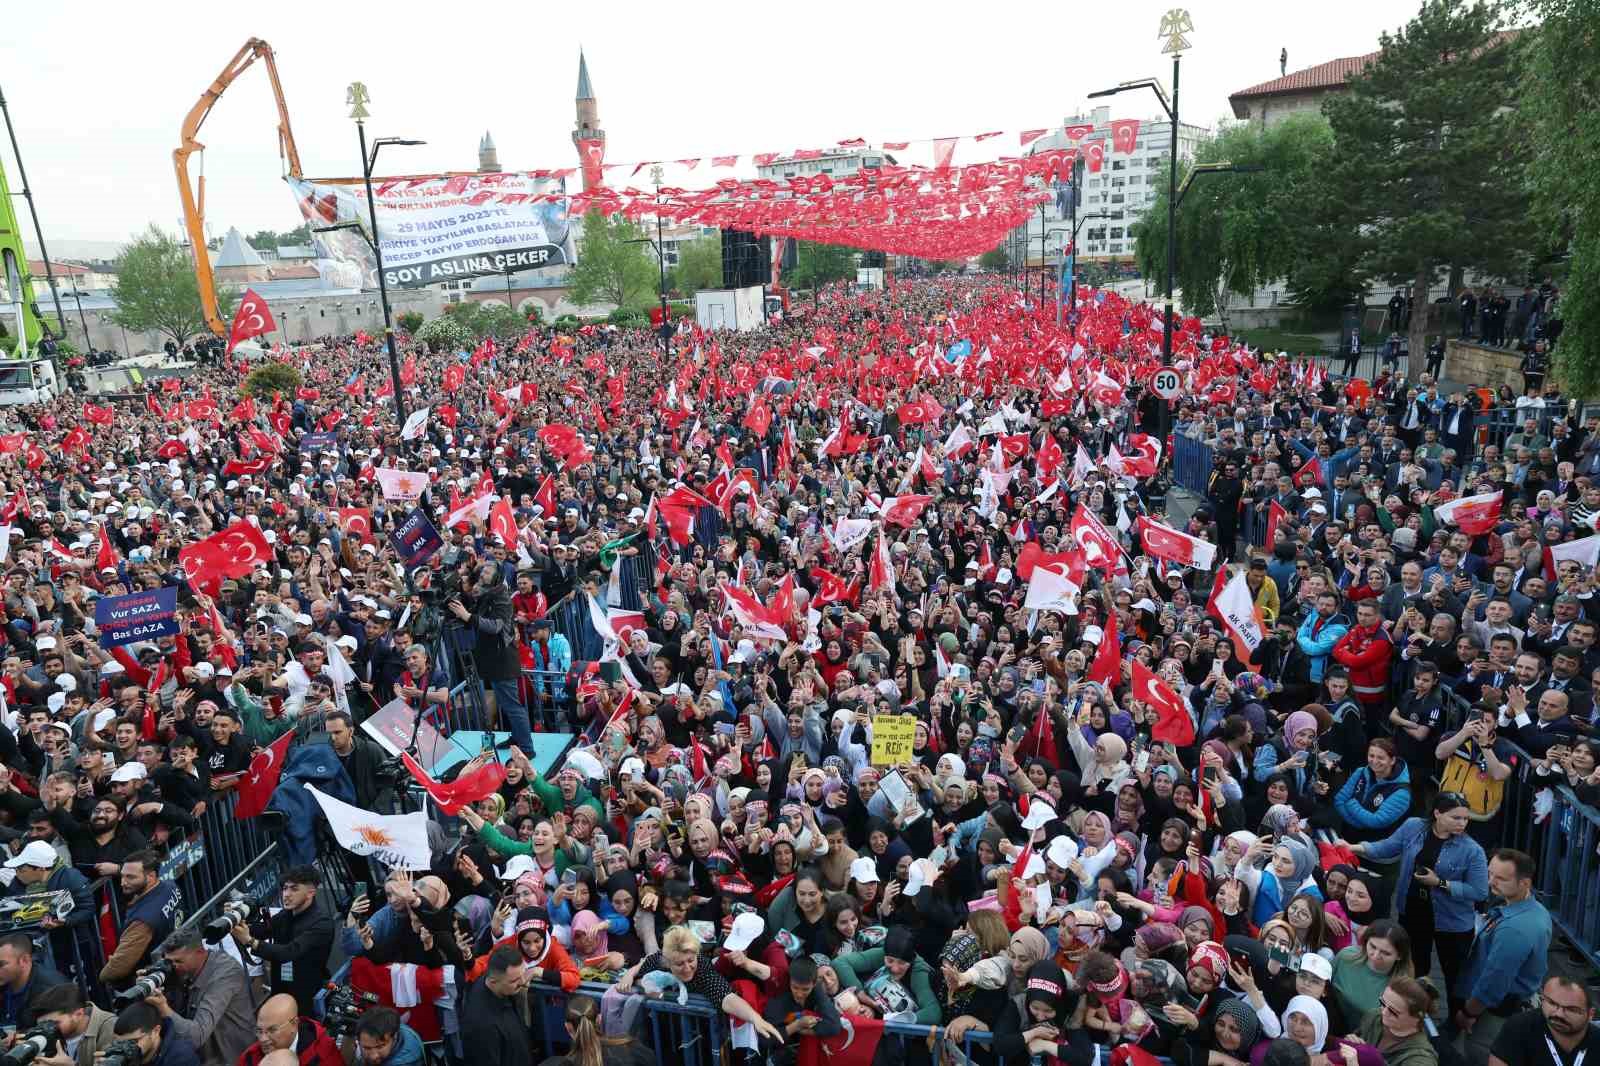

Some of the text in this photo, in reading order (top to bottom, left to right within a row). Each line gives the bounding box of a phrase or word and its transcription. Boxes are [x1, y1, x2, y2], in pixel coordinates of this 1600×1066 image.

[416, 217, 457, 231] MAYIS
[384, 250, 422, 263] RECEP
[385, 249, 549, 286] SOY ASLINA ÇEKER
[1157, 375, 1175, 390] 50
[111, 602, 160, 619] Vur SAZA
[112, 623, 165, 640] Bas GAZA
